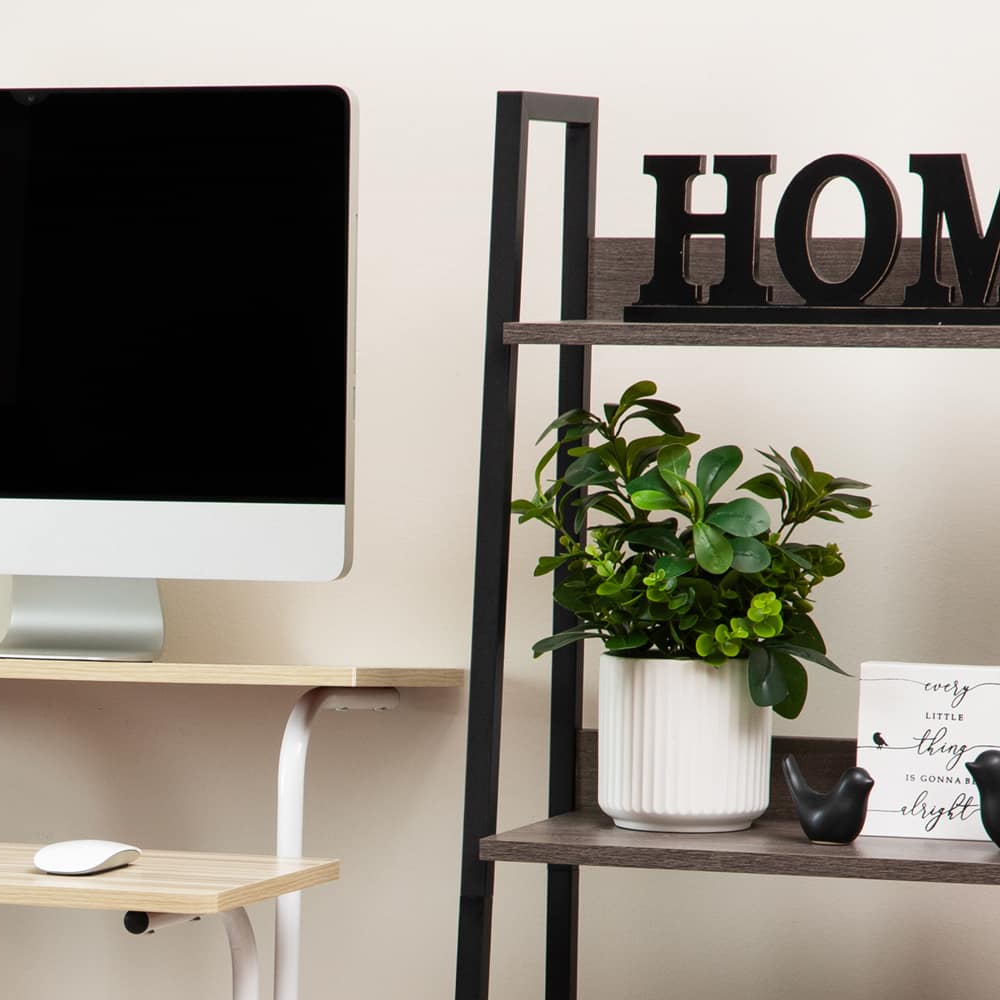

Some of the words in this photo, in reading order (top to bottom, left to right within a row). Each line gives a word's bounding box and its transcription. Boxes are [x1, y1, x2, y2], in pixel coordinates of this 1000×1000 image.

[924, 680, 971, 708] every
[925, 712, 965, 722] LITTLE
[913, 727, 969, 771] thing
[905, 774, 916, 783] IS
[920, 775, 962, 785] GONNA
[901, 790, 982, 832] alright
